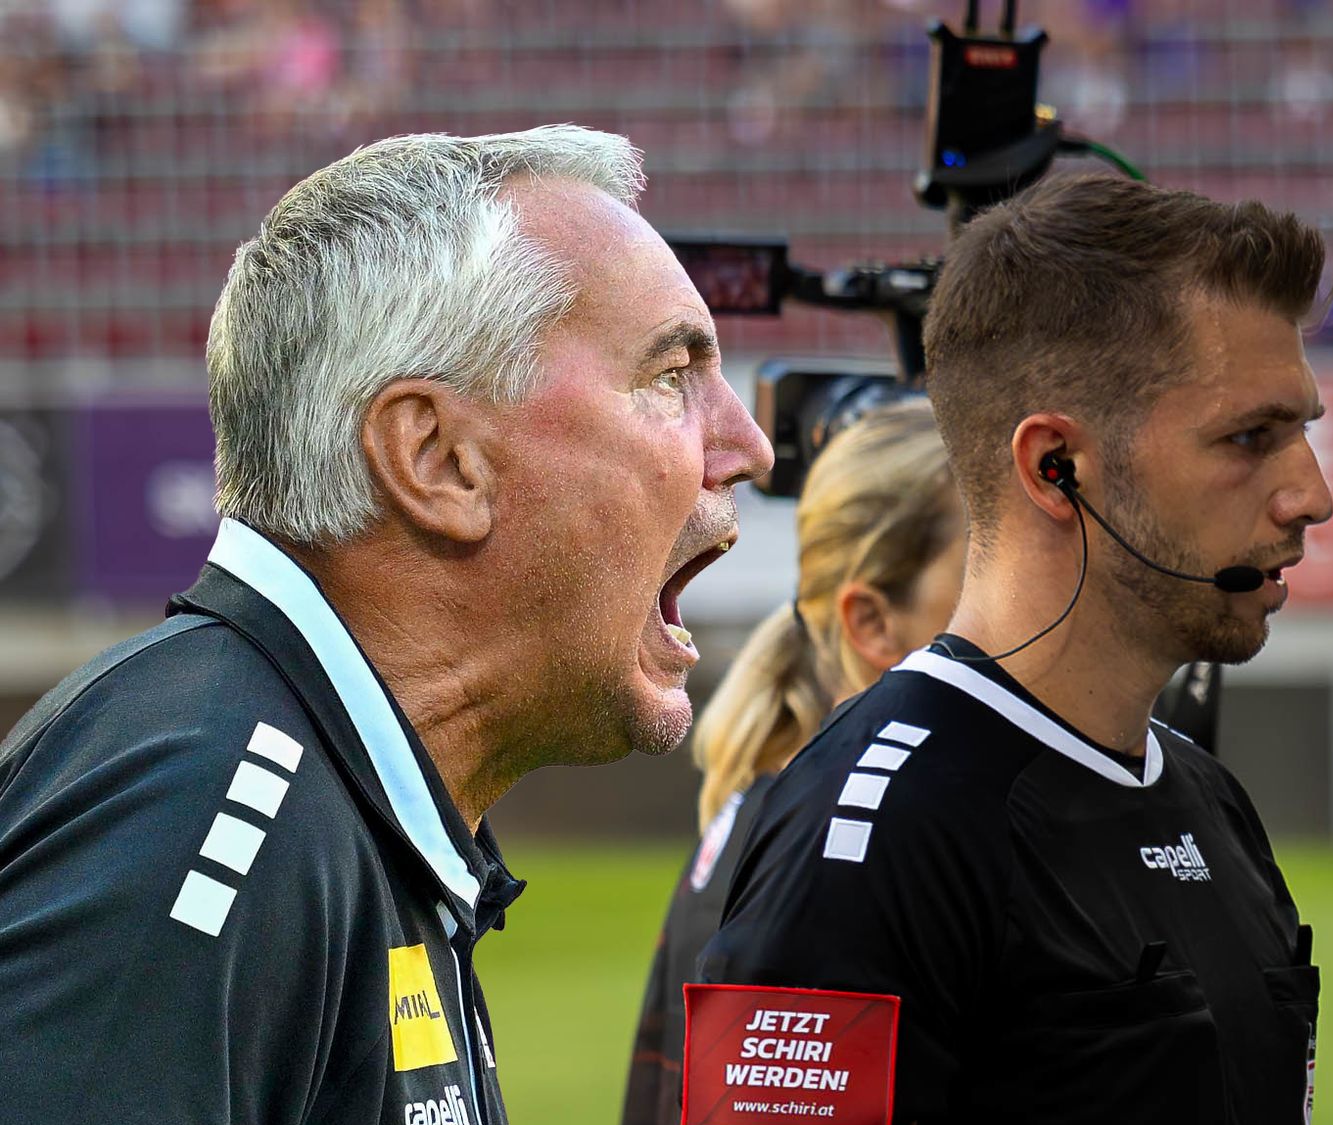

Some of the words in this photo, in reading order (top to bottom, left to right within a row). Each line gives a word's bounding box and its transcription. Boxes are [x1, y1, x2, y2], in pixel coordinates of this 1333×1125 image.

[1140, 833, 1206, 877] capelli
[1177, 868, 1211, 881] SPORT
[745, 1009, 830, 1034] JETZT
[740, 1037, 833, 1062] SCHIRI
[725, 1063, 849, 1091] WERDEN!
[733, 1100, 835, 1117] www.schiri.at
